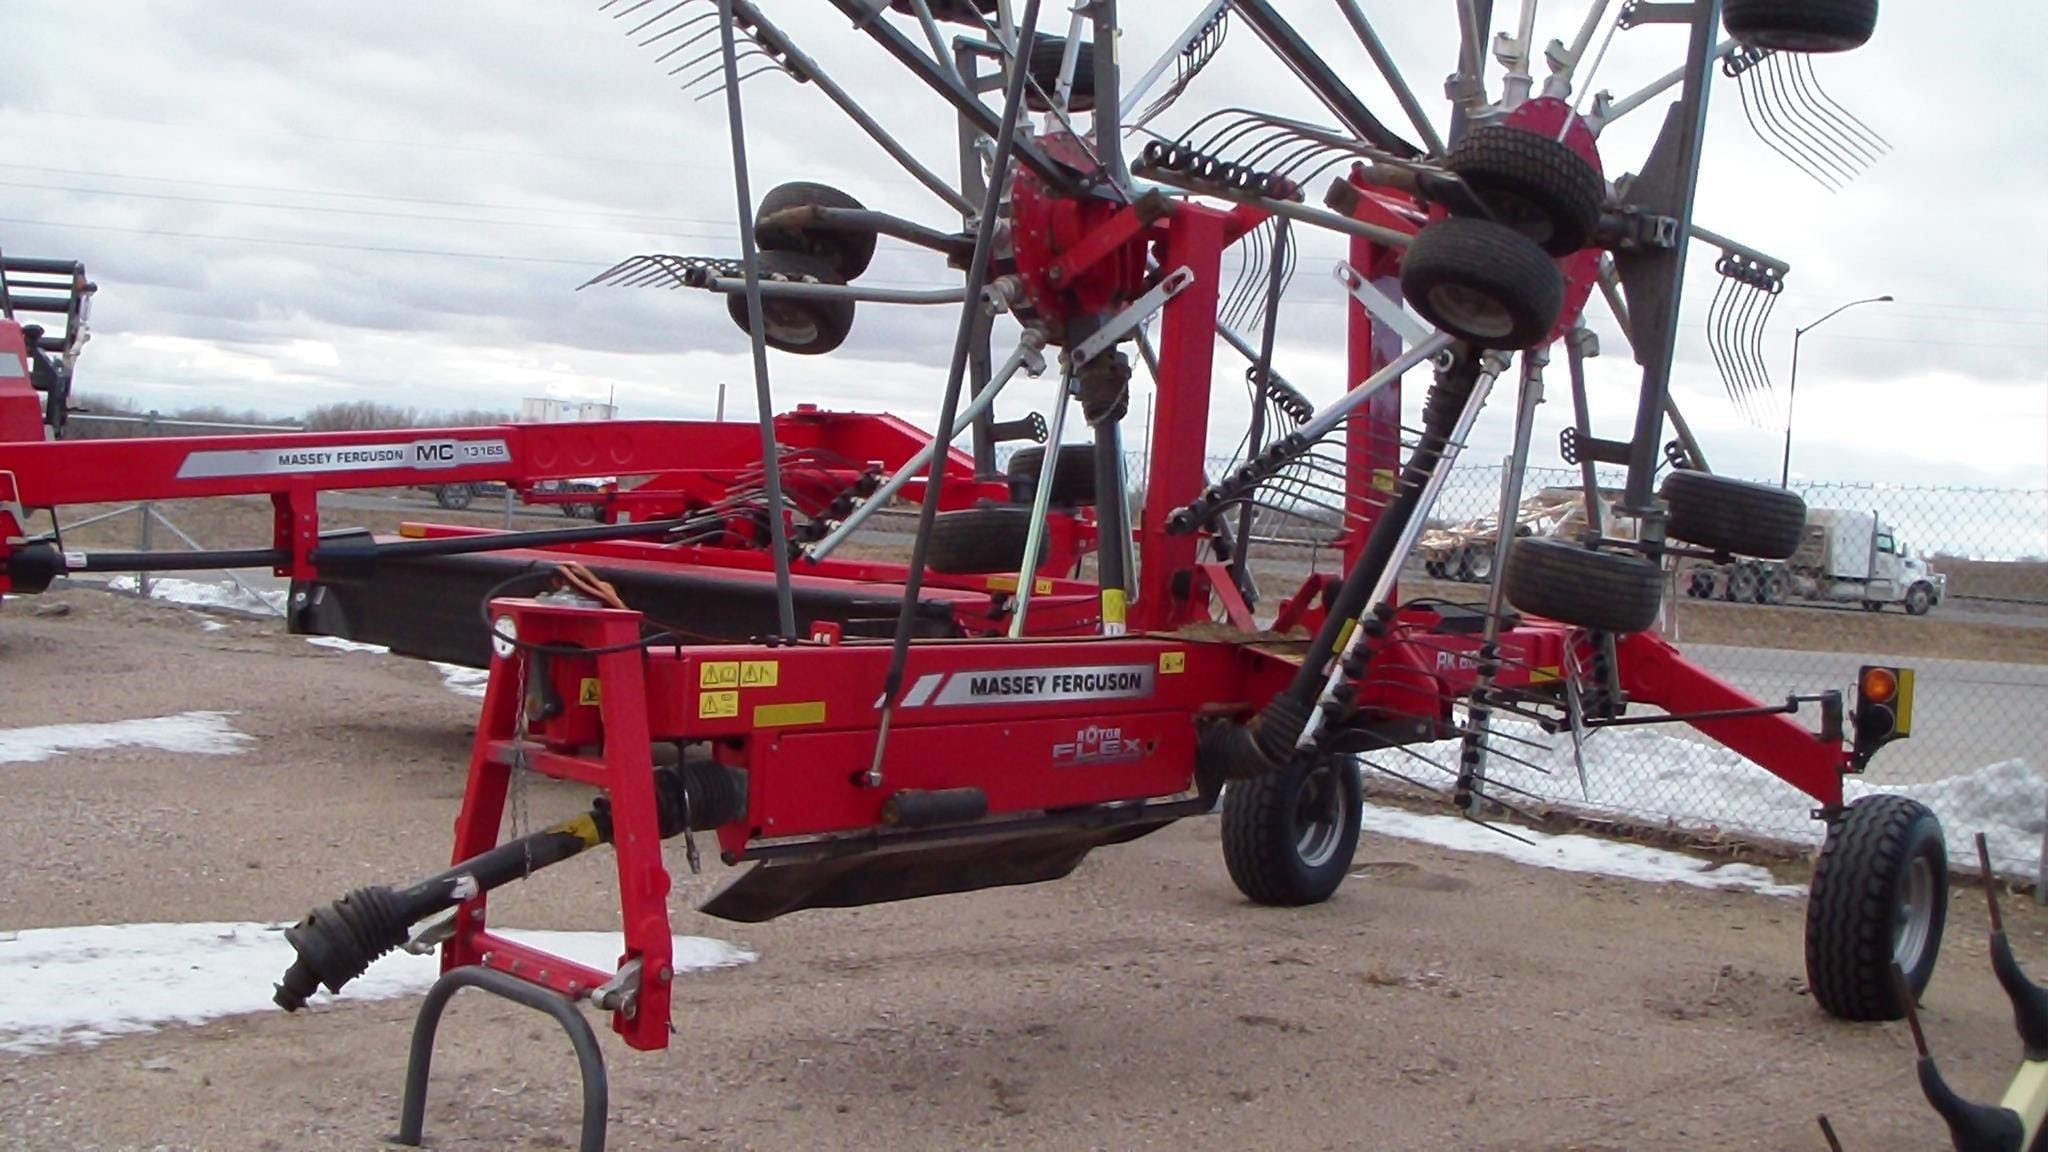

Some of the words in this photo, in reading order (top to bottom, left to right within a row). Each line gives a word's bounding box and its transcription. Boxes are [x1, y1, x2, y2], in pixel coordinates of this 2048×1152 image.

[278, 451, 332, 466] MASSEY
[336, 450, 404, 463] FERGUSON
[416, 444, 454, 461] MC
[970, 675, 1046, 696] MASSEY
[1051, 672, 1142, 693] FERGUSON
[1077, 725, 1122, 743] ROTOR
[1053, 738, 1141, 759] FLEX
